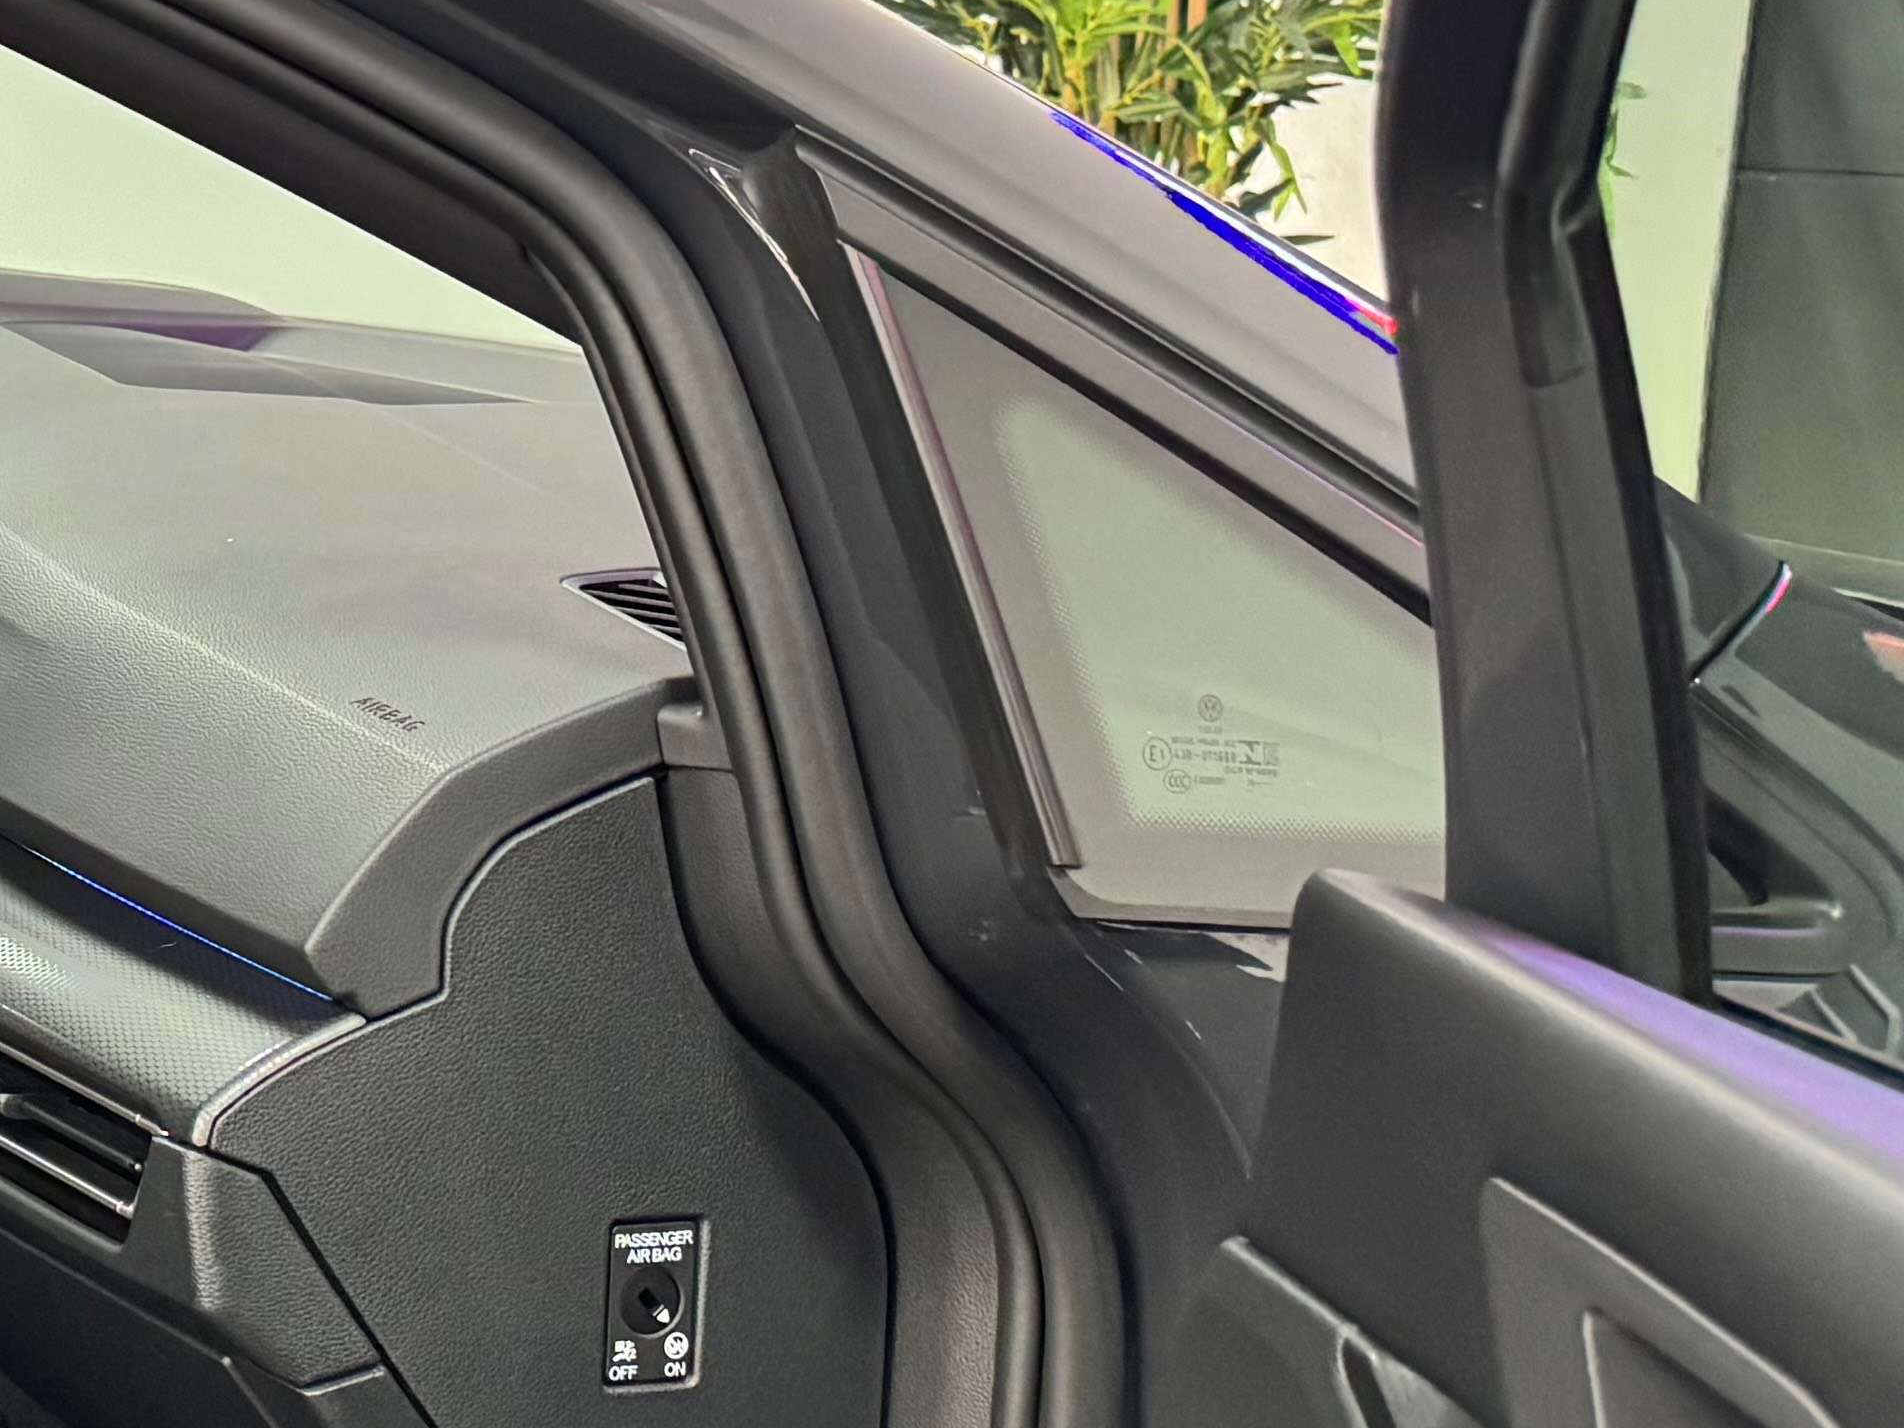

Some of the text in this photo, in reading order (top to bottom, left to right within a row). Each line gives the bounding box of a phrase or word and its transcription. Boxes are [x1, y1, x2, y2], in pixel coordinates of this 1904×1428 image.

[349, 697, 426, 732] AIRBAG
[614, 1229, 694, 1249] PASSENGER
[608, 1361, 686, 1381] OFF ON
